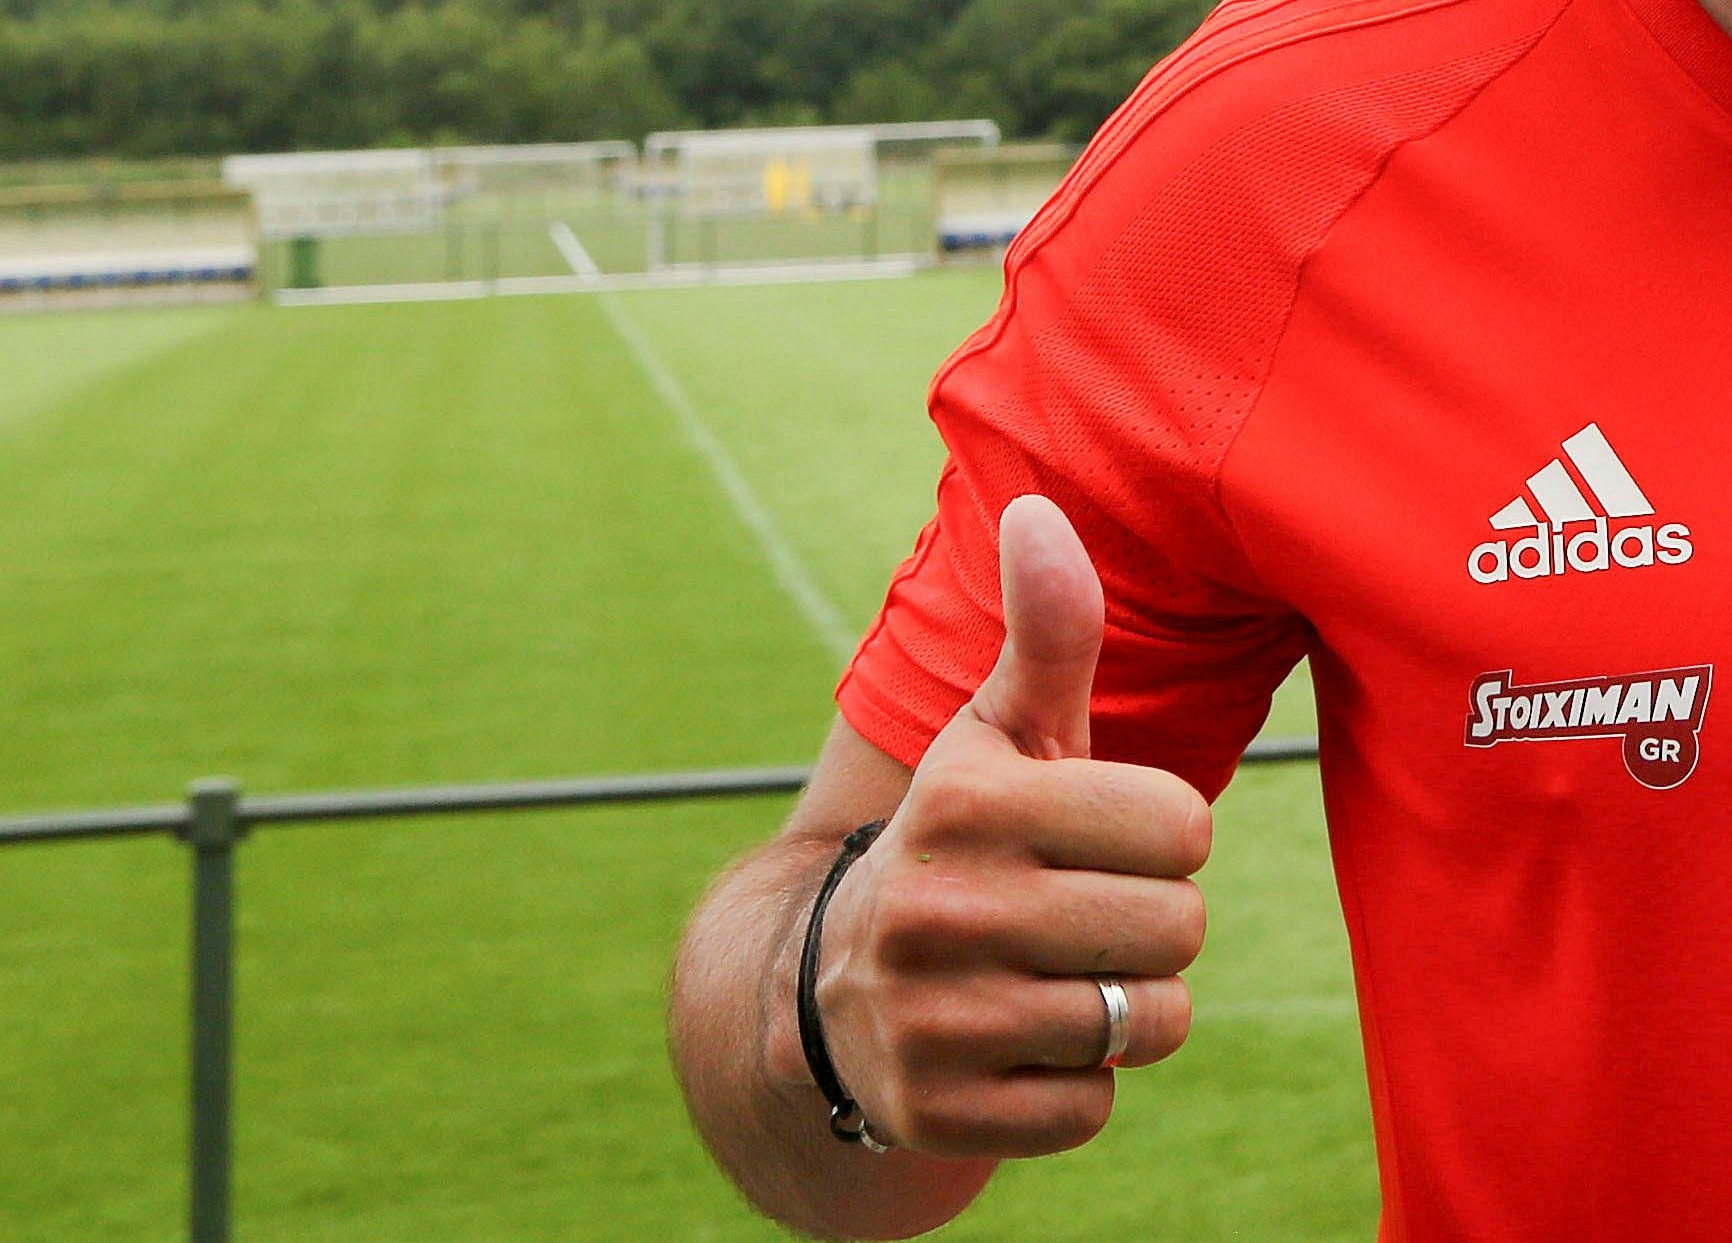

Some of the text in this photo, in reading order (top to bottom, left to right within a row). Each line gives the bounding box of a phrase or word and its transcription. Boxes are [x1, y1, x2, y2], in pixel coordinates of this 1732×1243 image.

[1467, 517, 1694, 583] adidas
[1472, 675, 1699, 737] STOIXIMAN
[1640, 737, 1681, 763] GR
